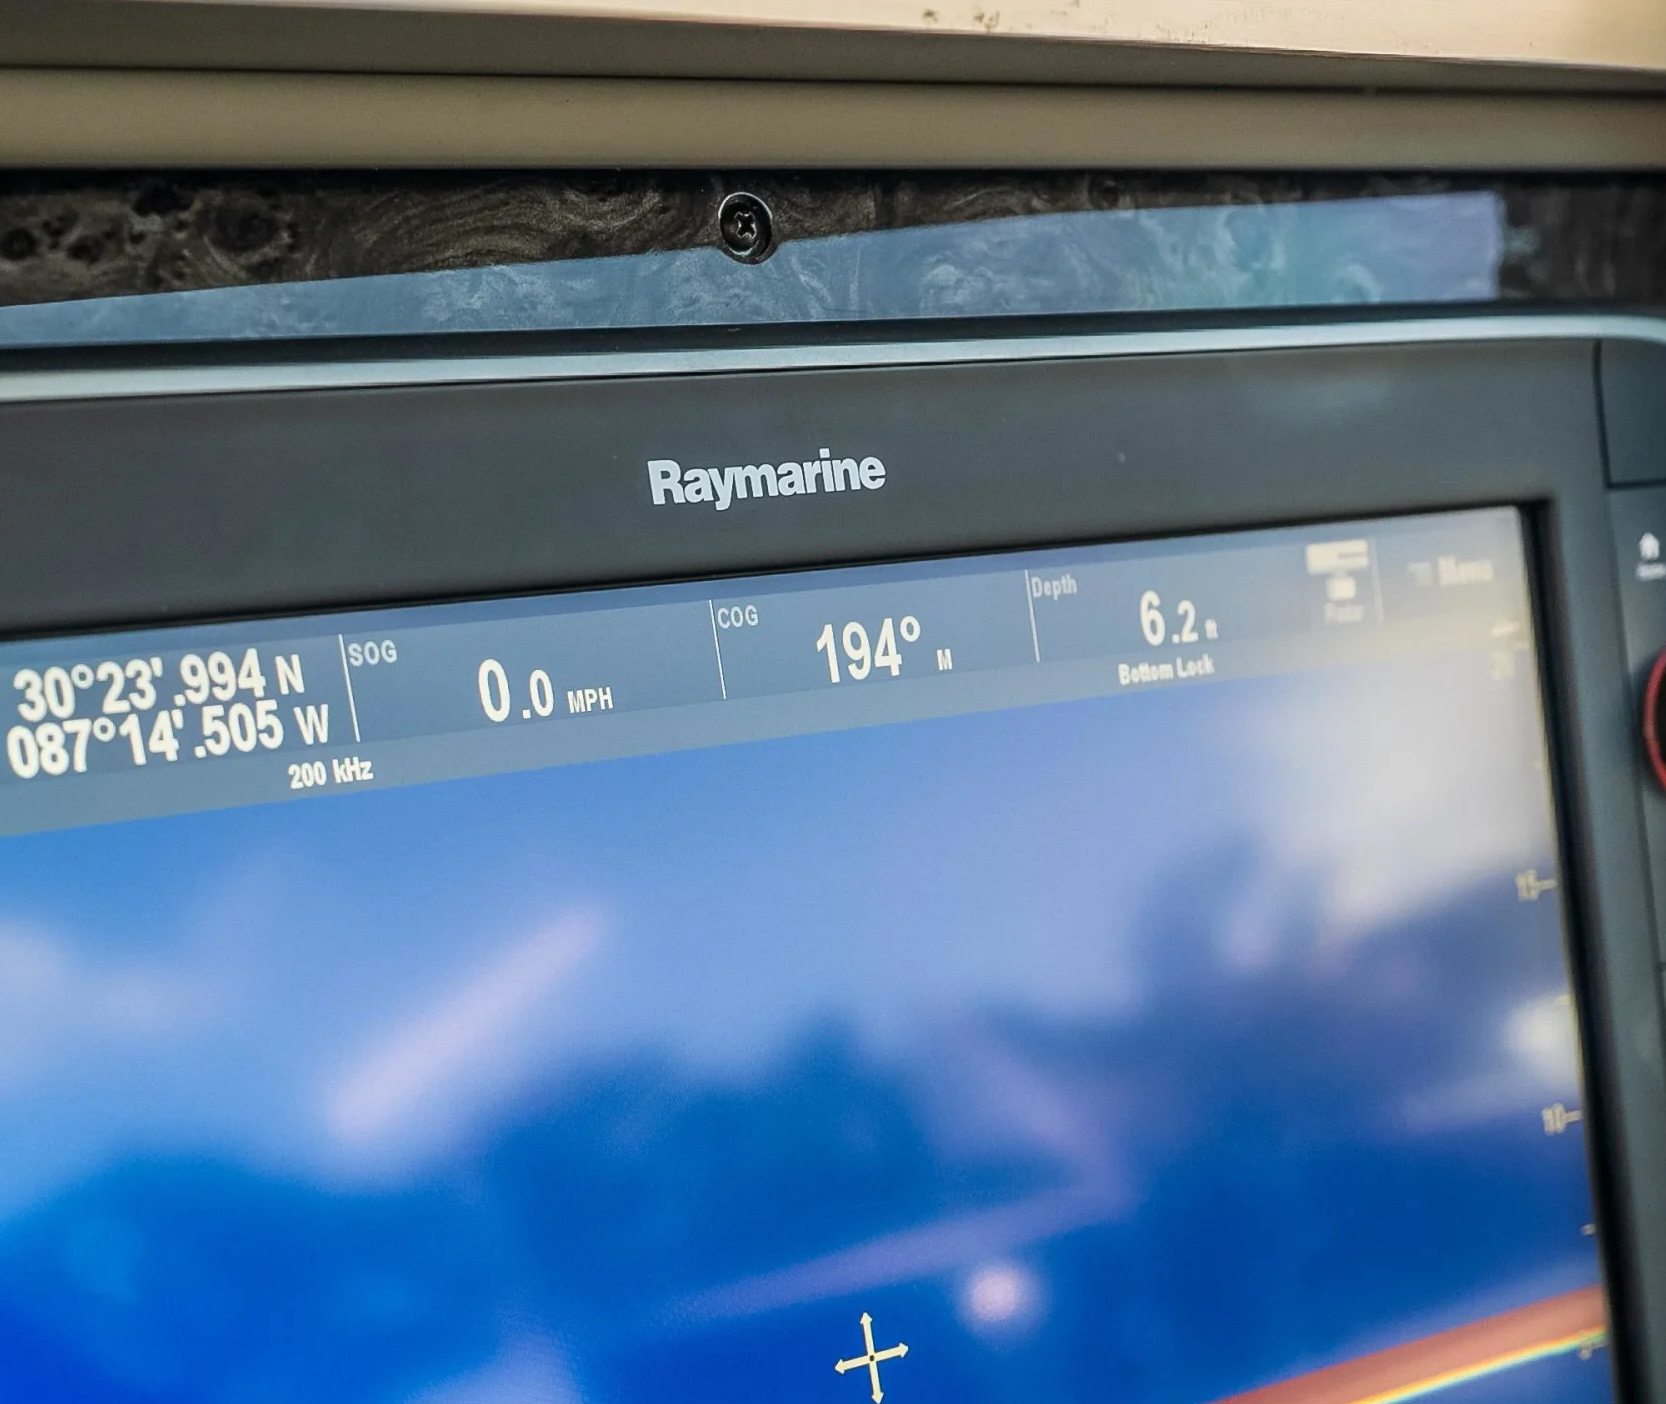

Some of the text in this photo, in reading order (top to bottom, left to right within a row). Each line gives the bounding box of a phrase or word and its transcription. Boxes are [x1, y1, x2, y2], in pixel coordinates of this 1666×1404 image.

[647, 448, 886, 511] Raymarine
[1032, 574, 1078, 601] Depth
[717, 605, 759, 630] COG
[1140, 589, 1199, 646] 6.2
[349, 640, 398, 667] SOG
[815, 615, 952, 684] 194° M
[1118, 654, 1214, 685] Bottom Lock
[275, 654, 305, 695] N
[478, 658, 613, 722] 0.0 MPH
[293, 704, 329, 745] W
[288, 757, 374, 789] 200 kHz
